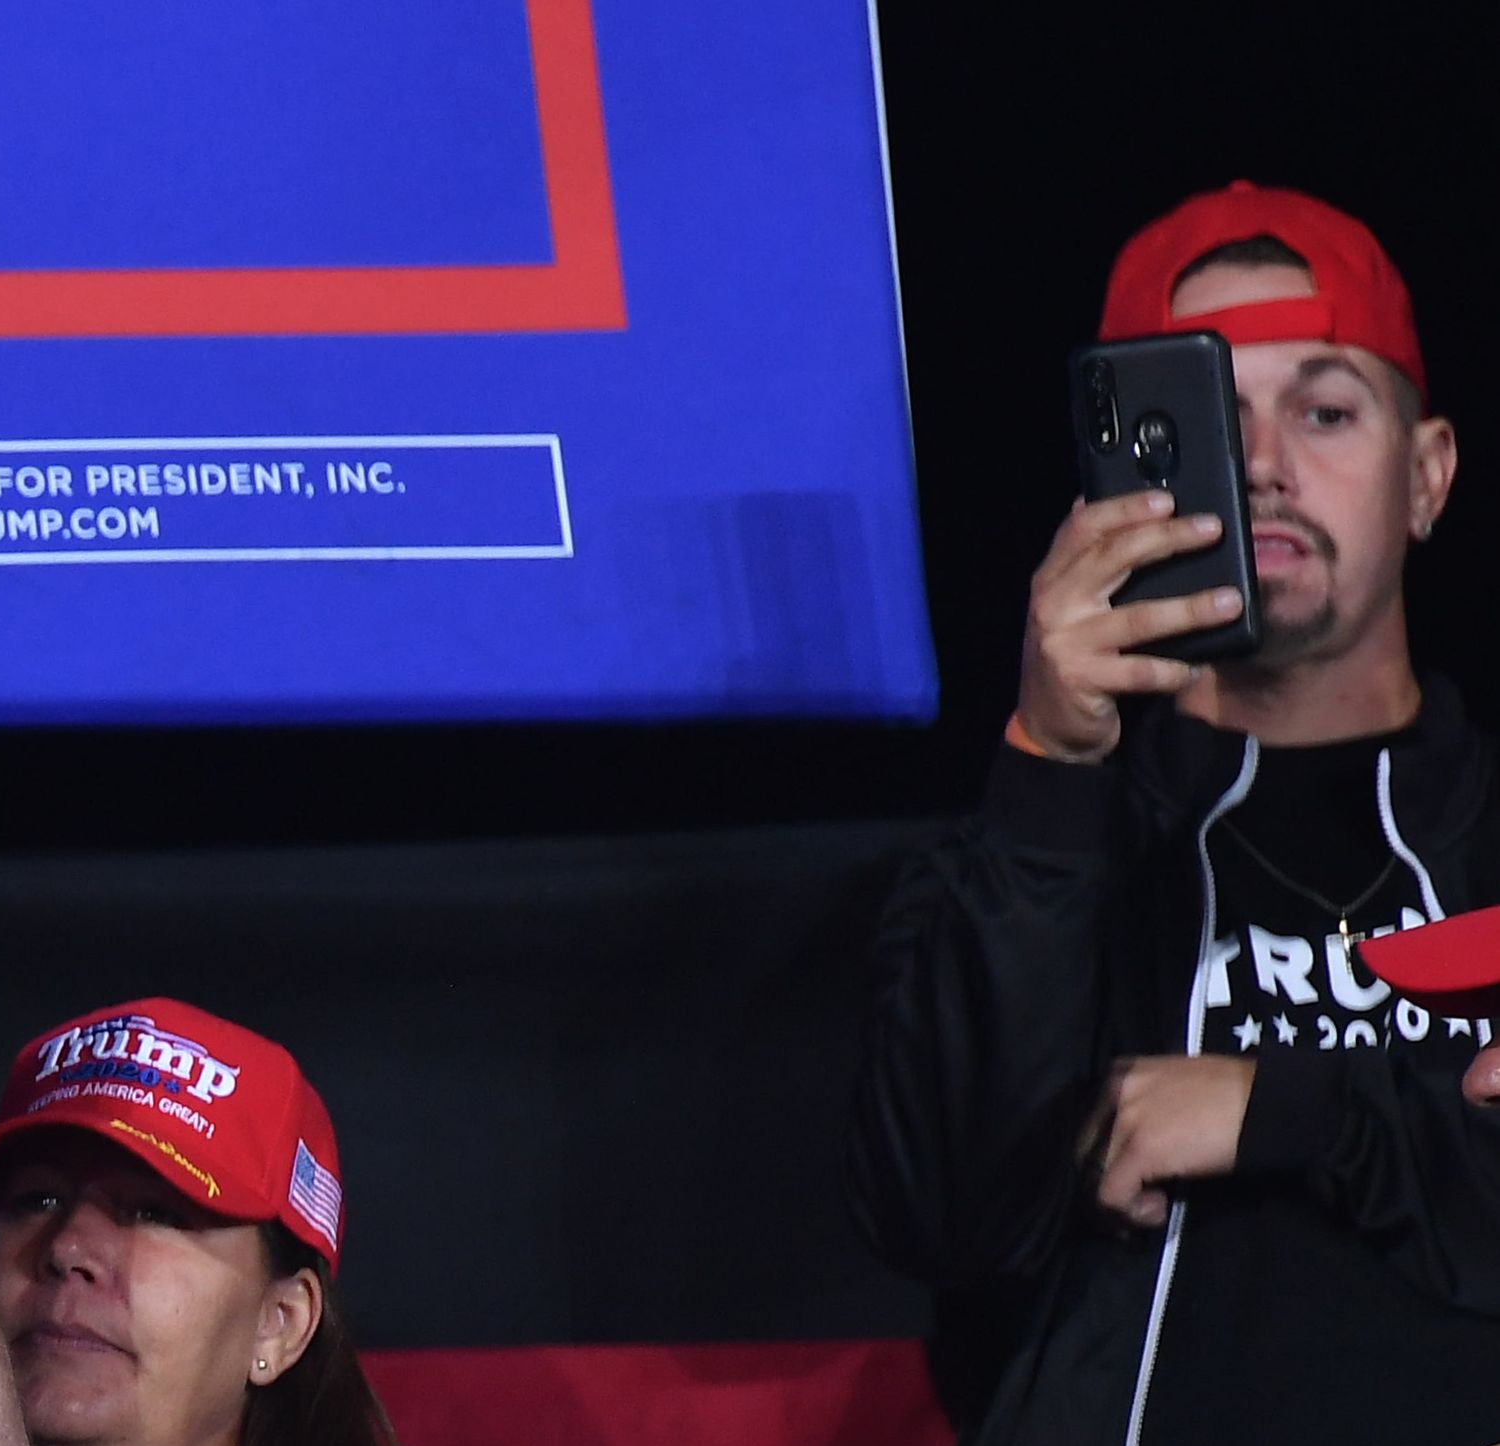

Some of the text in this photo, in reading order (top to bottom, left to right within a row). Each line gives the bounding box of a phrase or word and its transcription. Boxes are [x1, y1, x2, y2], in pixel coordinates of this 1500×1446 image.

[87, 461, 315, 498] PRESIDENT,
[327, 461, 406, 495] INC.
[36, 1027, 241, 1104] Trump
[73, 1060, 162, 1088] 2020
[82, 1082, 155, 1109] AMERICA
[159, 1097, 216, 1139] GREAT!
